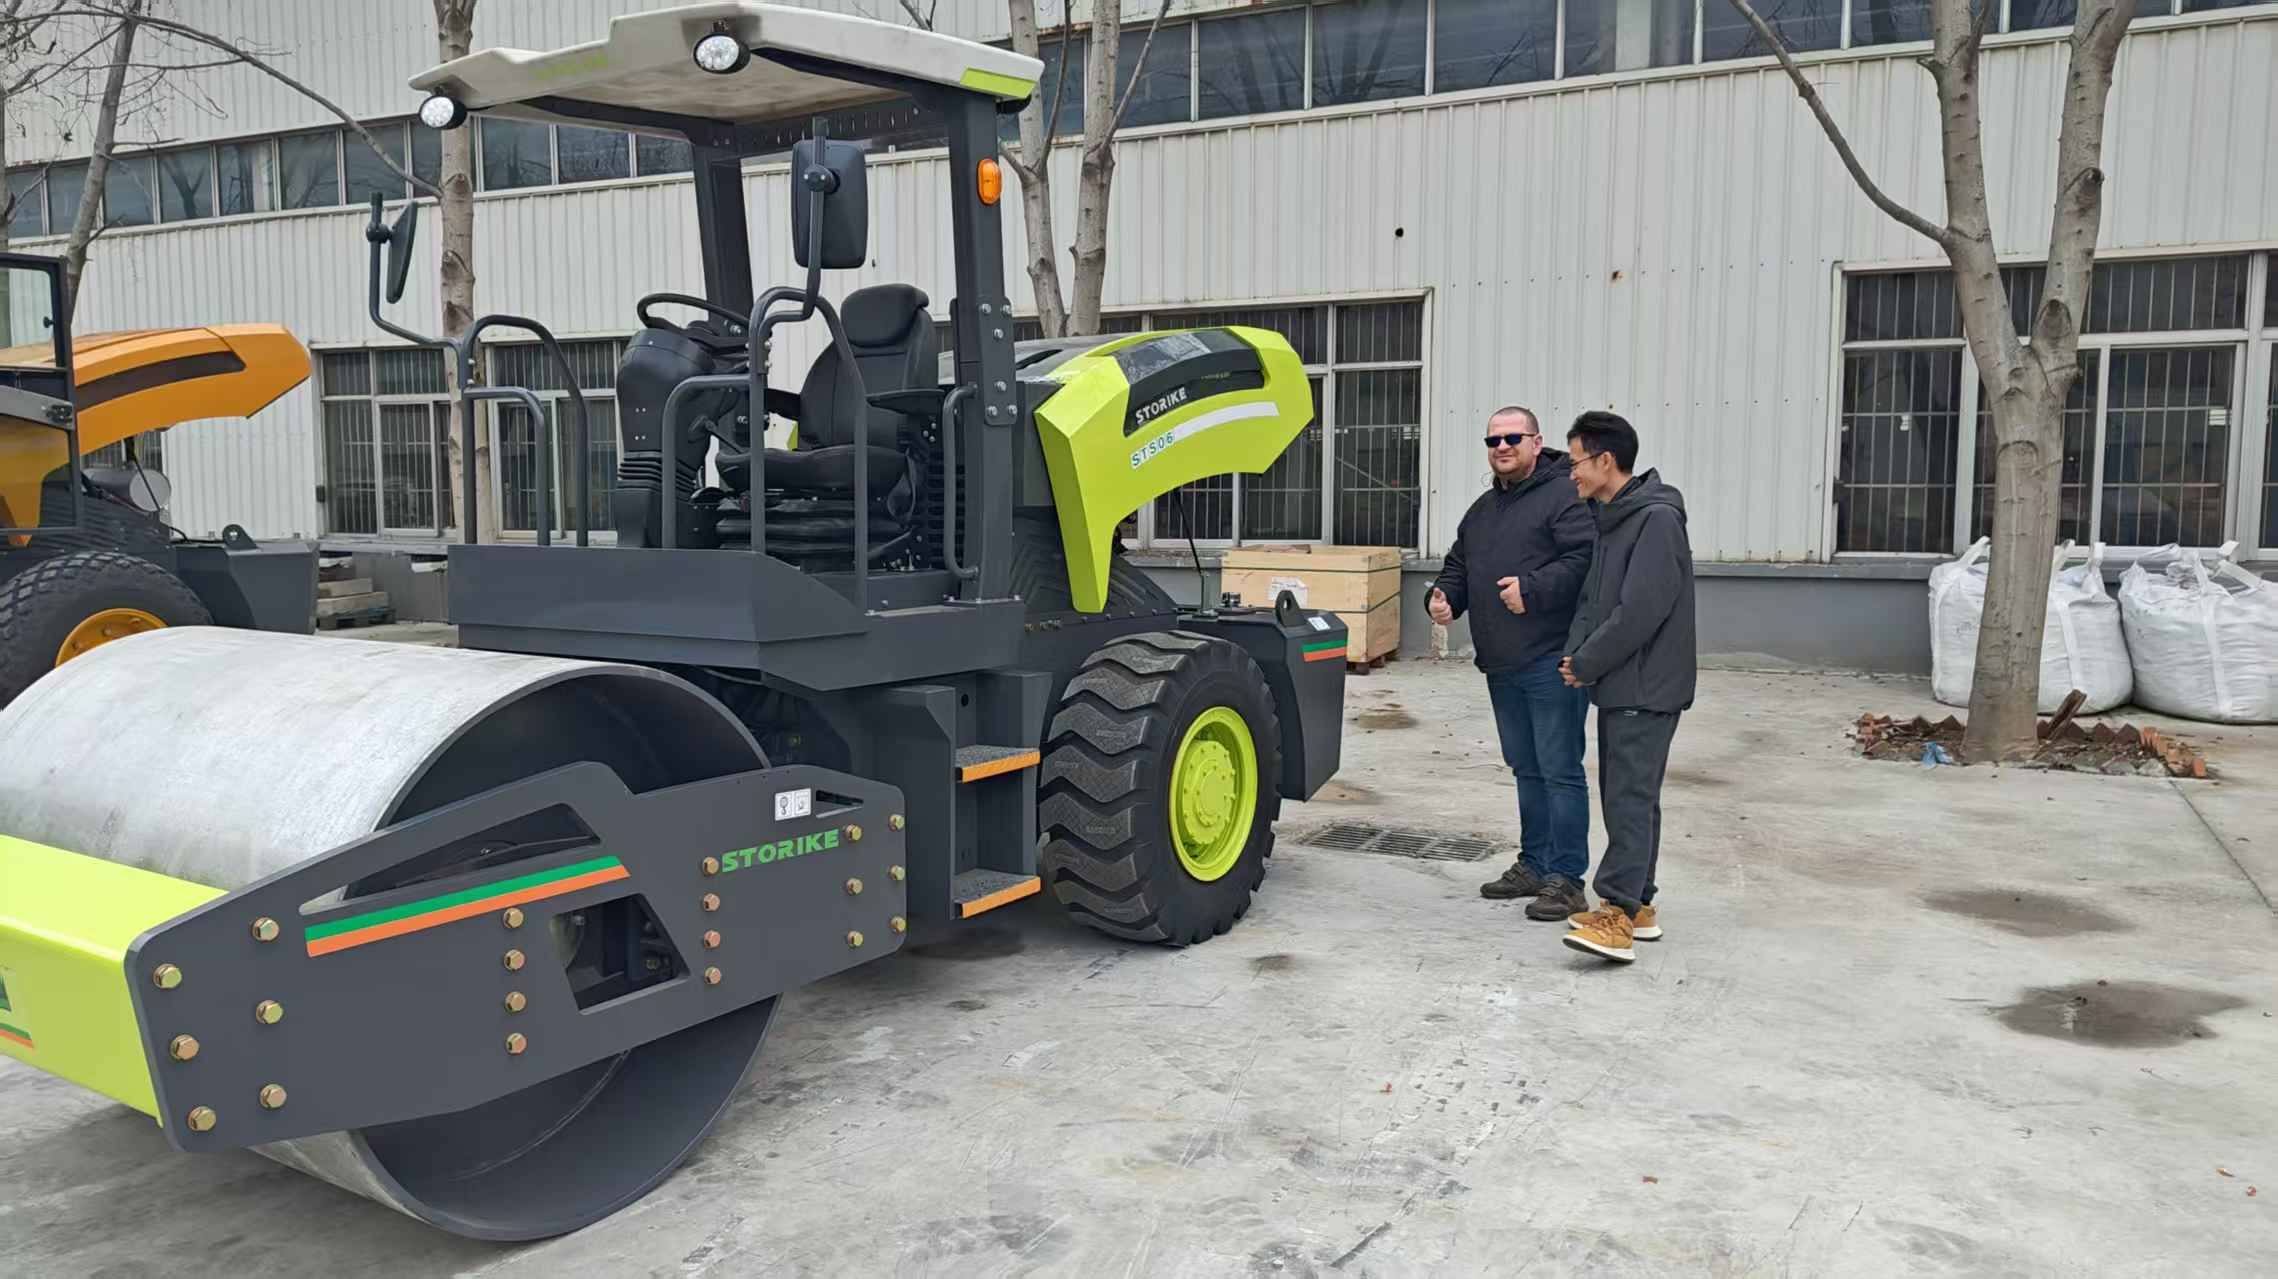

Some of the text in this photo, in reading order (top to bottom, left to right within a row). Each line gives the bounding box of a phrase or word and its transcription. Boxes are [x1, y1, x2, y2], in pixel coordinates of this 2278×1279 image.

[1135, 386, 1188, 426] STORIKE
[1131, 431, 1174, 466] STS06
[721, 828, 840, 873] STORIKE
